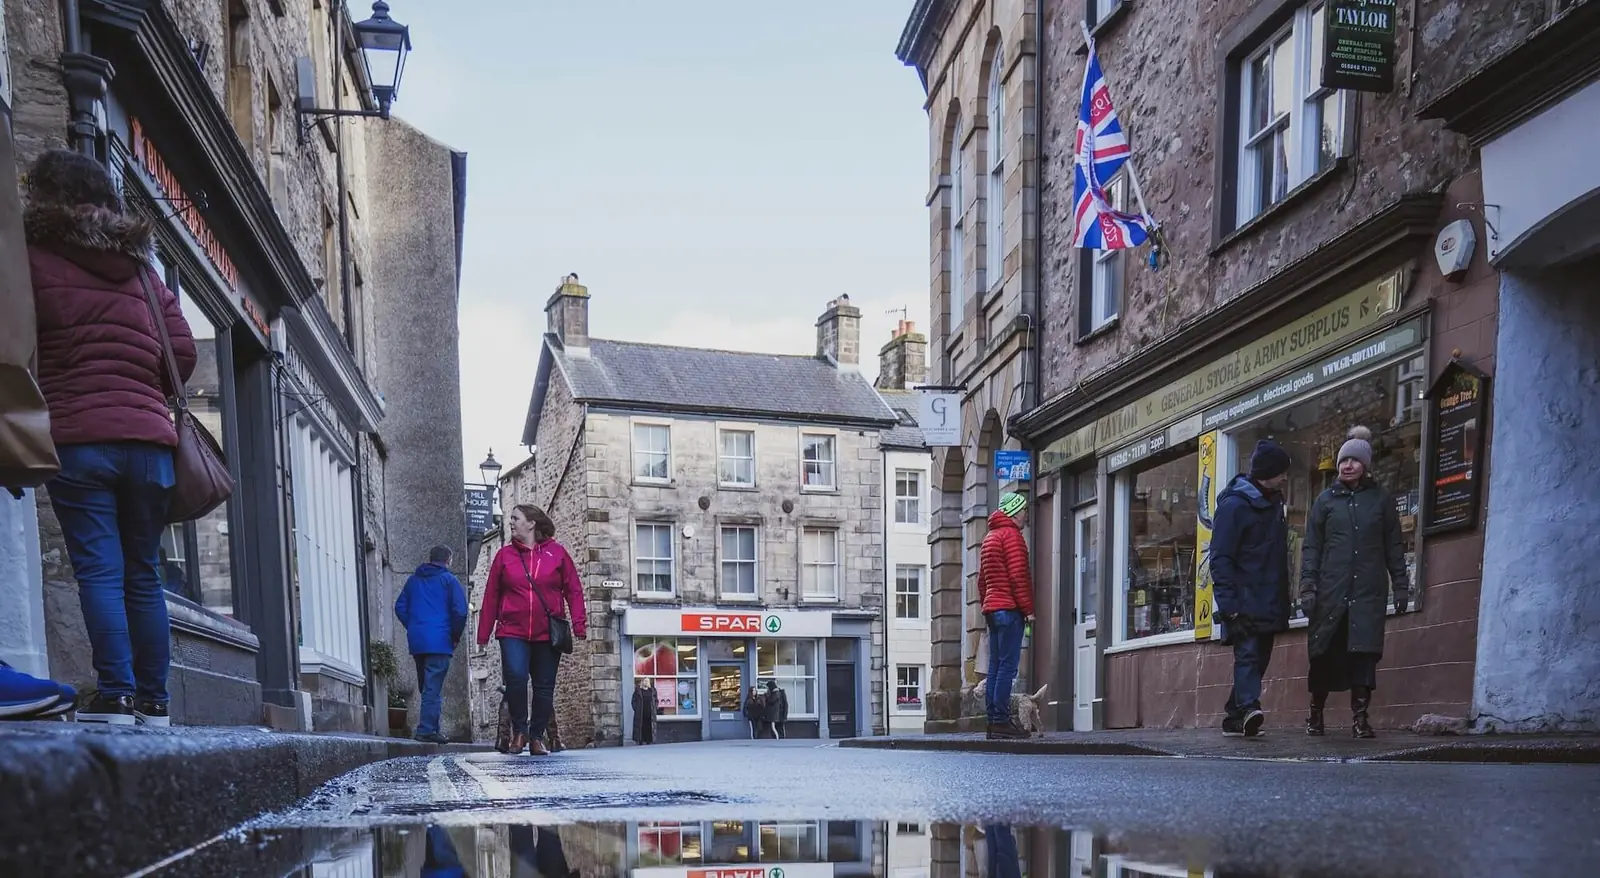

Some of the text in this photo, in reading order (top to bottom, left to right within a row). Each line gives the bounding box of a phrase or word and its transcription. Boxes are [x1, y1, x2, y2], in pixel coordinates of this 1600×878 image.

[1336, 8, 1387, 29] TAYLOR
[1099, 404, 1139, 444] TAYLOR
[1161, 378, 1205, 413] GENERAL
[1206, 361, 1241, 391] STORE
[1243, 355, 1251, 374] &
[1253, 336, 1288, 370] ARMY
[1289, 305, 1350, 353] SURPLUS
[1205, 408, 1229, 427] camping
[1229, 395, 1260, 417] equipment
[1263, 379, 1293, 402] electrical
[1293, 371, 1314, 392] goods
[699, 616, 761, 630] SPAR
